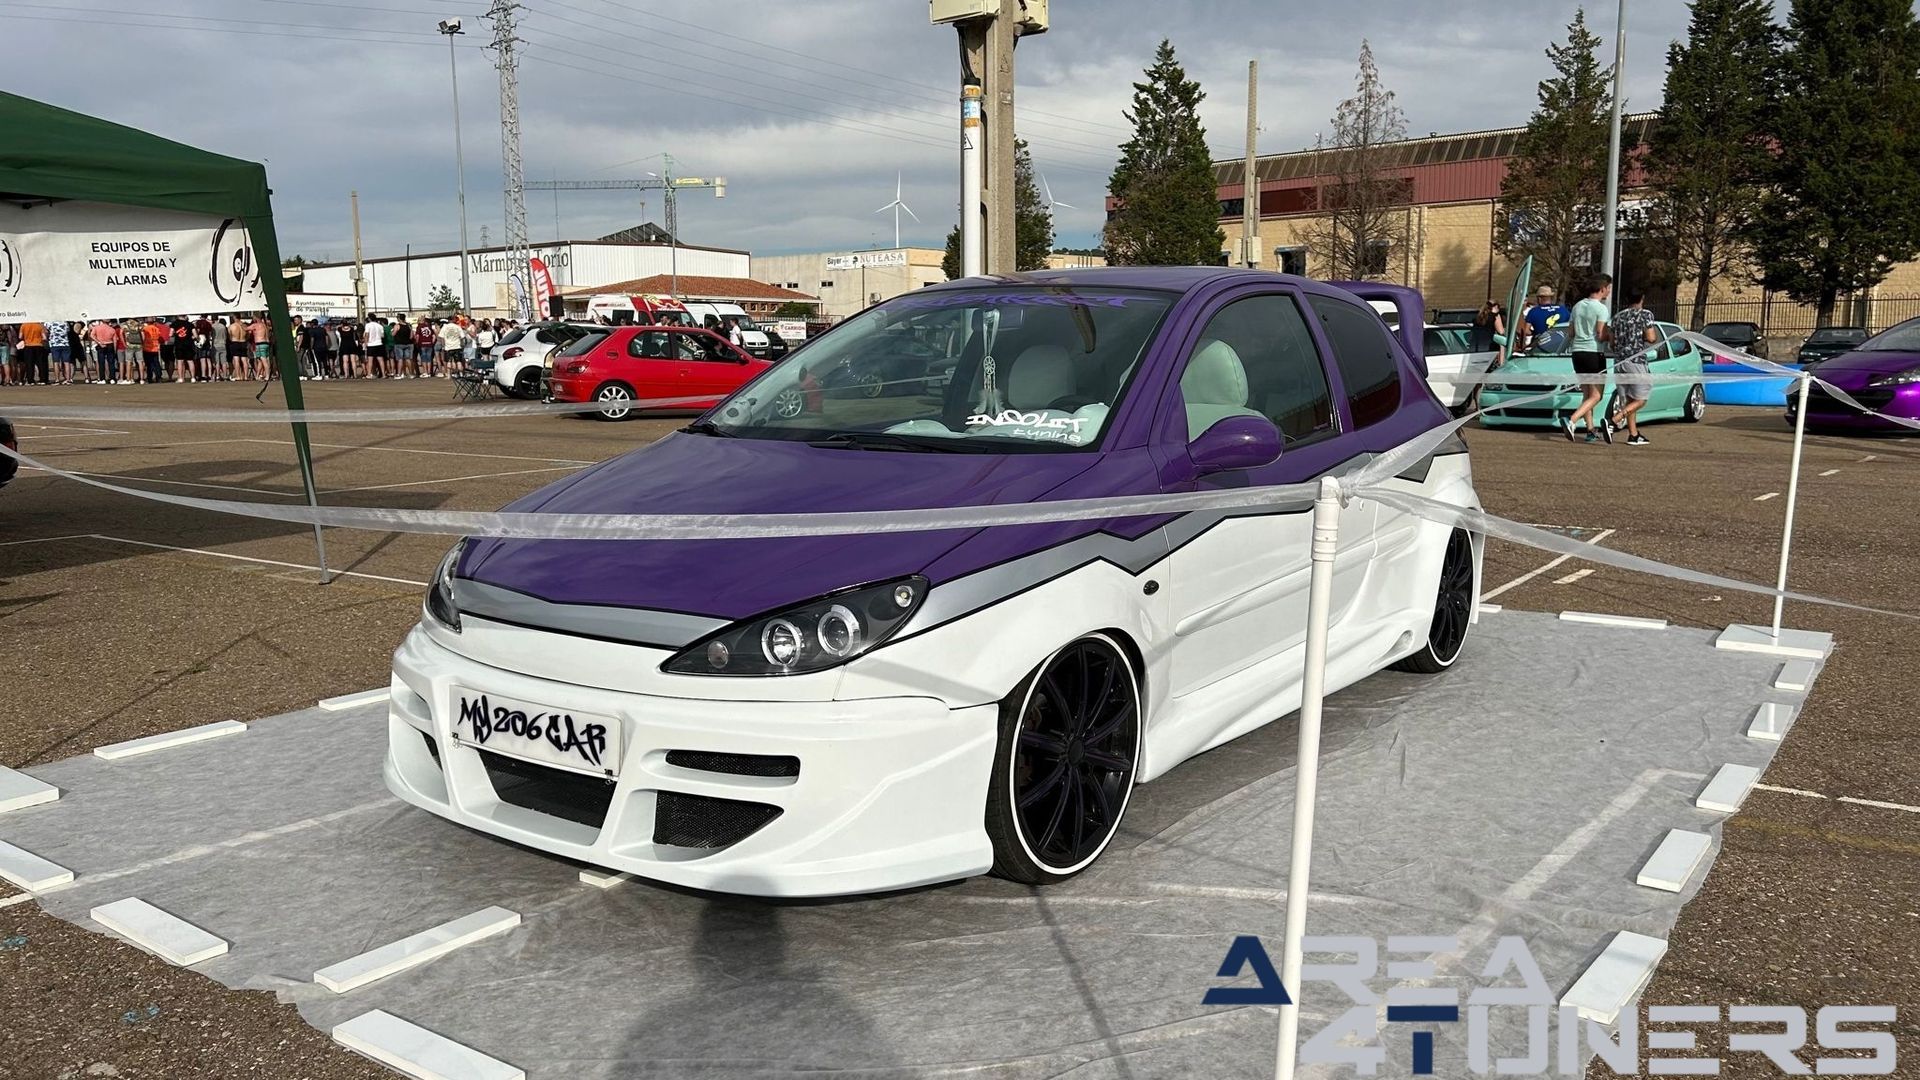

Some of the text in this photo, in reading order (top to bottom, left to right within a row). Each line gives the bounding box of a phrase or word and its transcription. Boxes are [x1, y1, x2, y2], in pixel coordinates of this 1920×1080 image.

[91, 241, 171, 253] EQUIPOS DE
[88, 258, 177, 269] MULTIMEDIA Y
[471, 251, 529, 274] Mármo
[827, 257, 842, 266] Bayer
[860, 252, 904, 264] NUTEASA
[106, 274, 168, 286] ALARMAS
